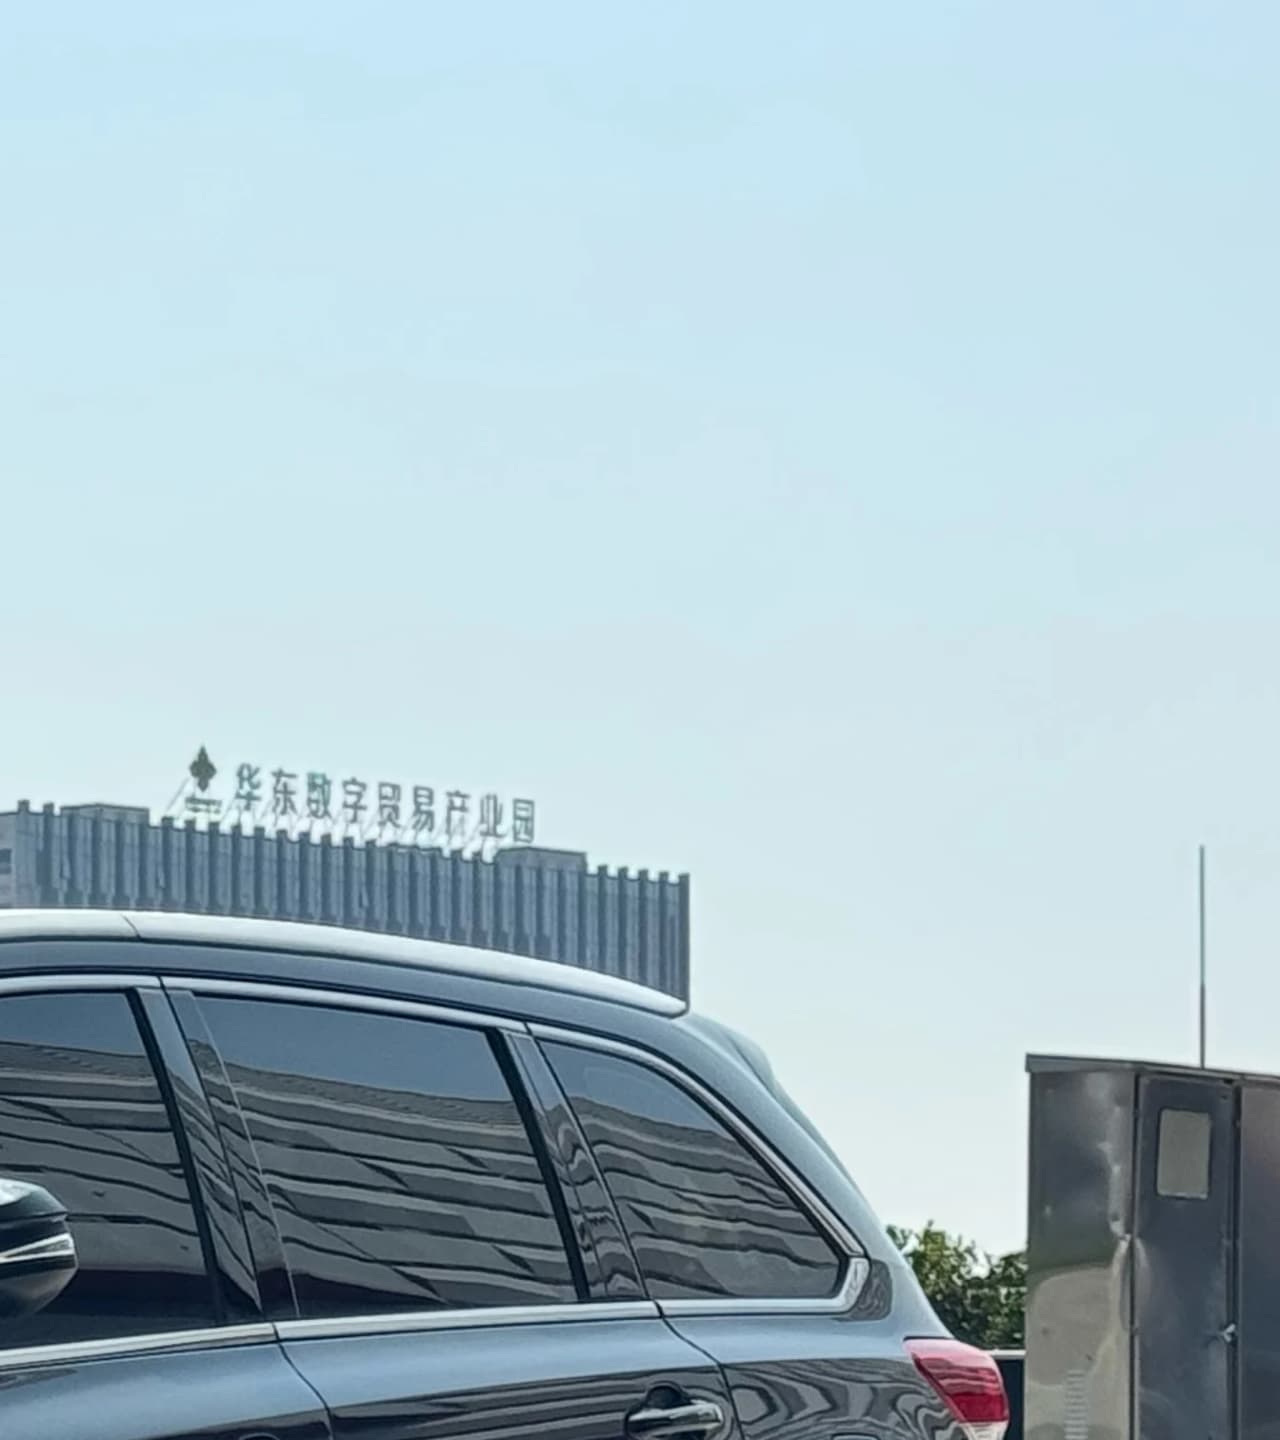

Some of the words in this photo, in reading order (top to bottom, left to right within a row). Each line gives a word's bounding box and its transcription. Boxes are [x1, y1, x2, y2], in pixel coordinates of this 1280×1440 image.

[235, 763, 534, 843] 华东数字贸易产业园
